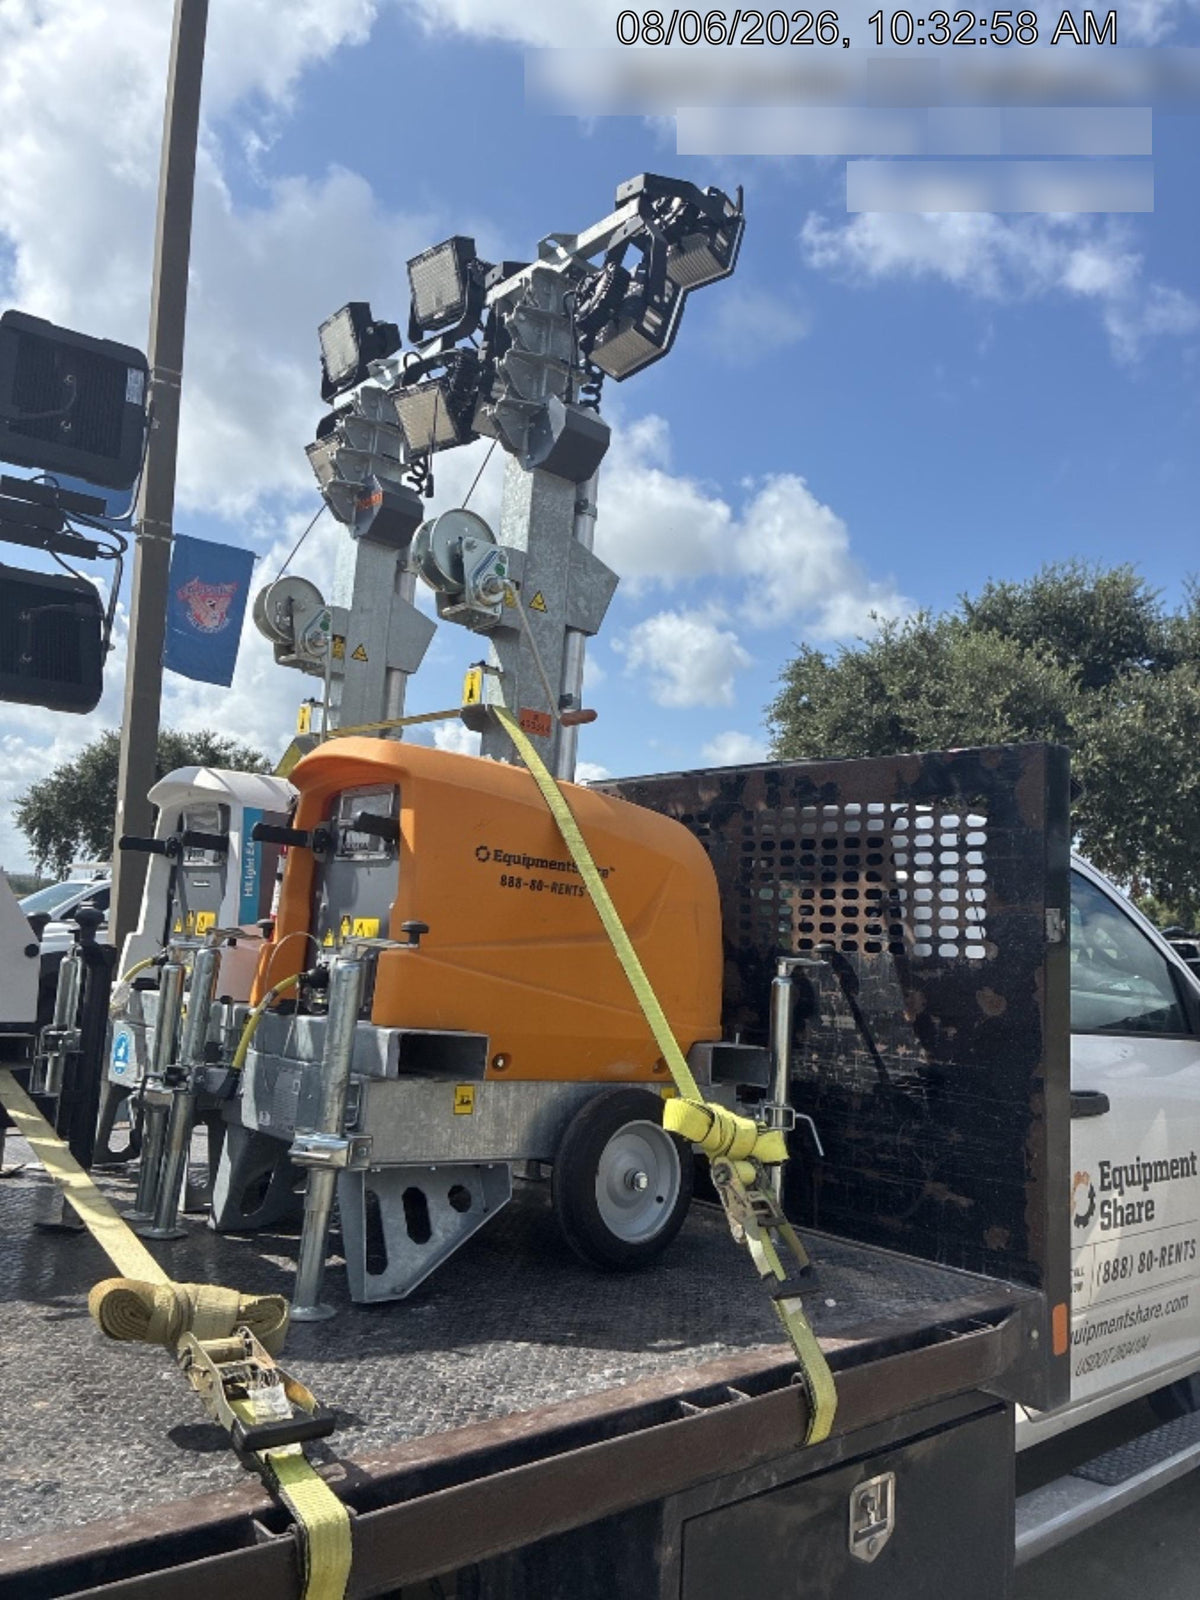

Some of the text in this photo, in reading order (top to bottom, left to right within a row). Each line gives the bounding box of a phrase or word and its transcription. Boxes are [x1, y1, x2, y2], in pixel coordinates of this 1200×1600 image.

[493, 849, 609, 879] EquipmentSe
[1098, 1150, 1198, 1197] Equipment
[1099, 1198, 1155, 1231] Share
[1096, 1253, 1134, 1287] (888)
[1137, 1238, 1197, 1274] 80-RENTS
[1070, 1294, 1189, 1346] uipmentshare.com
